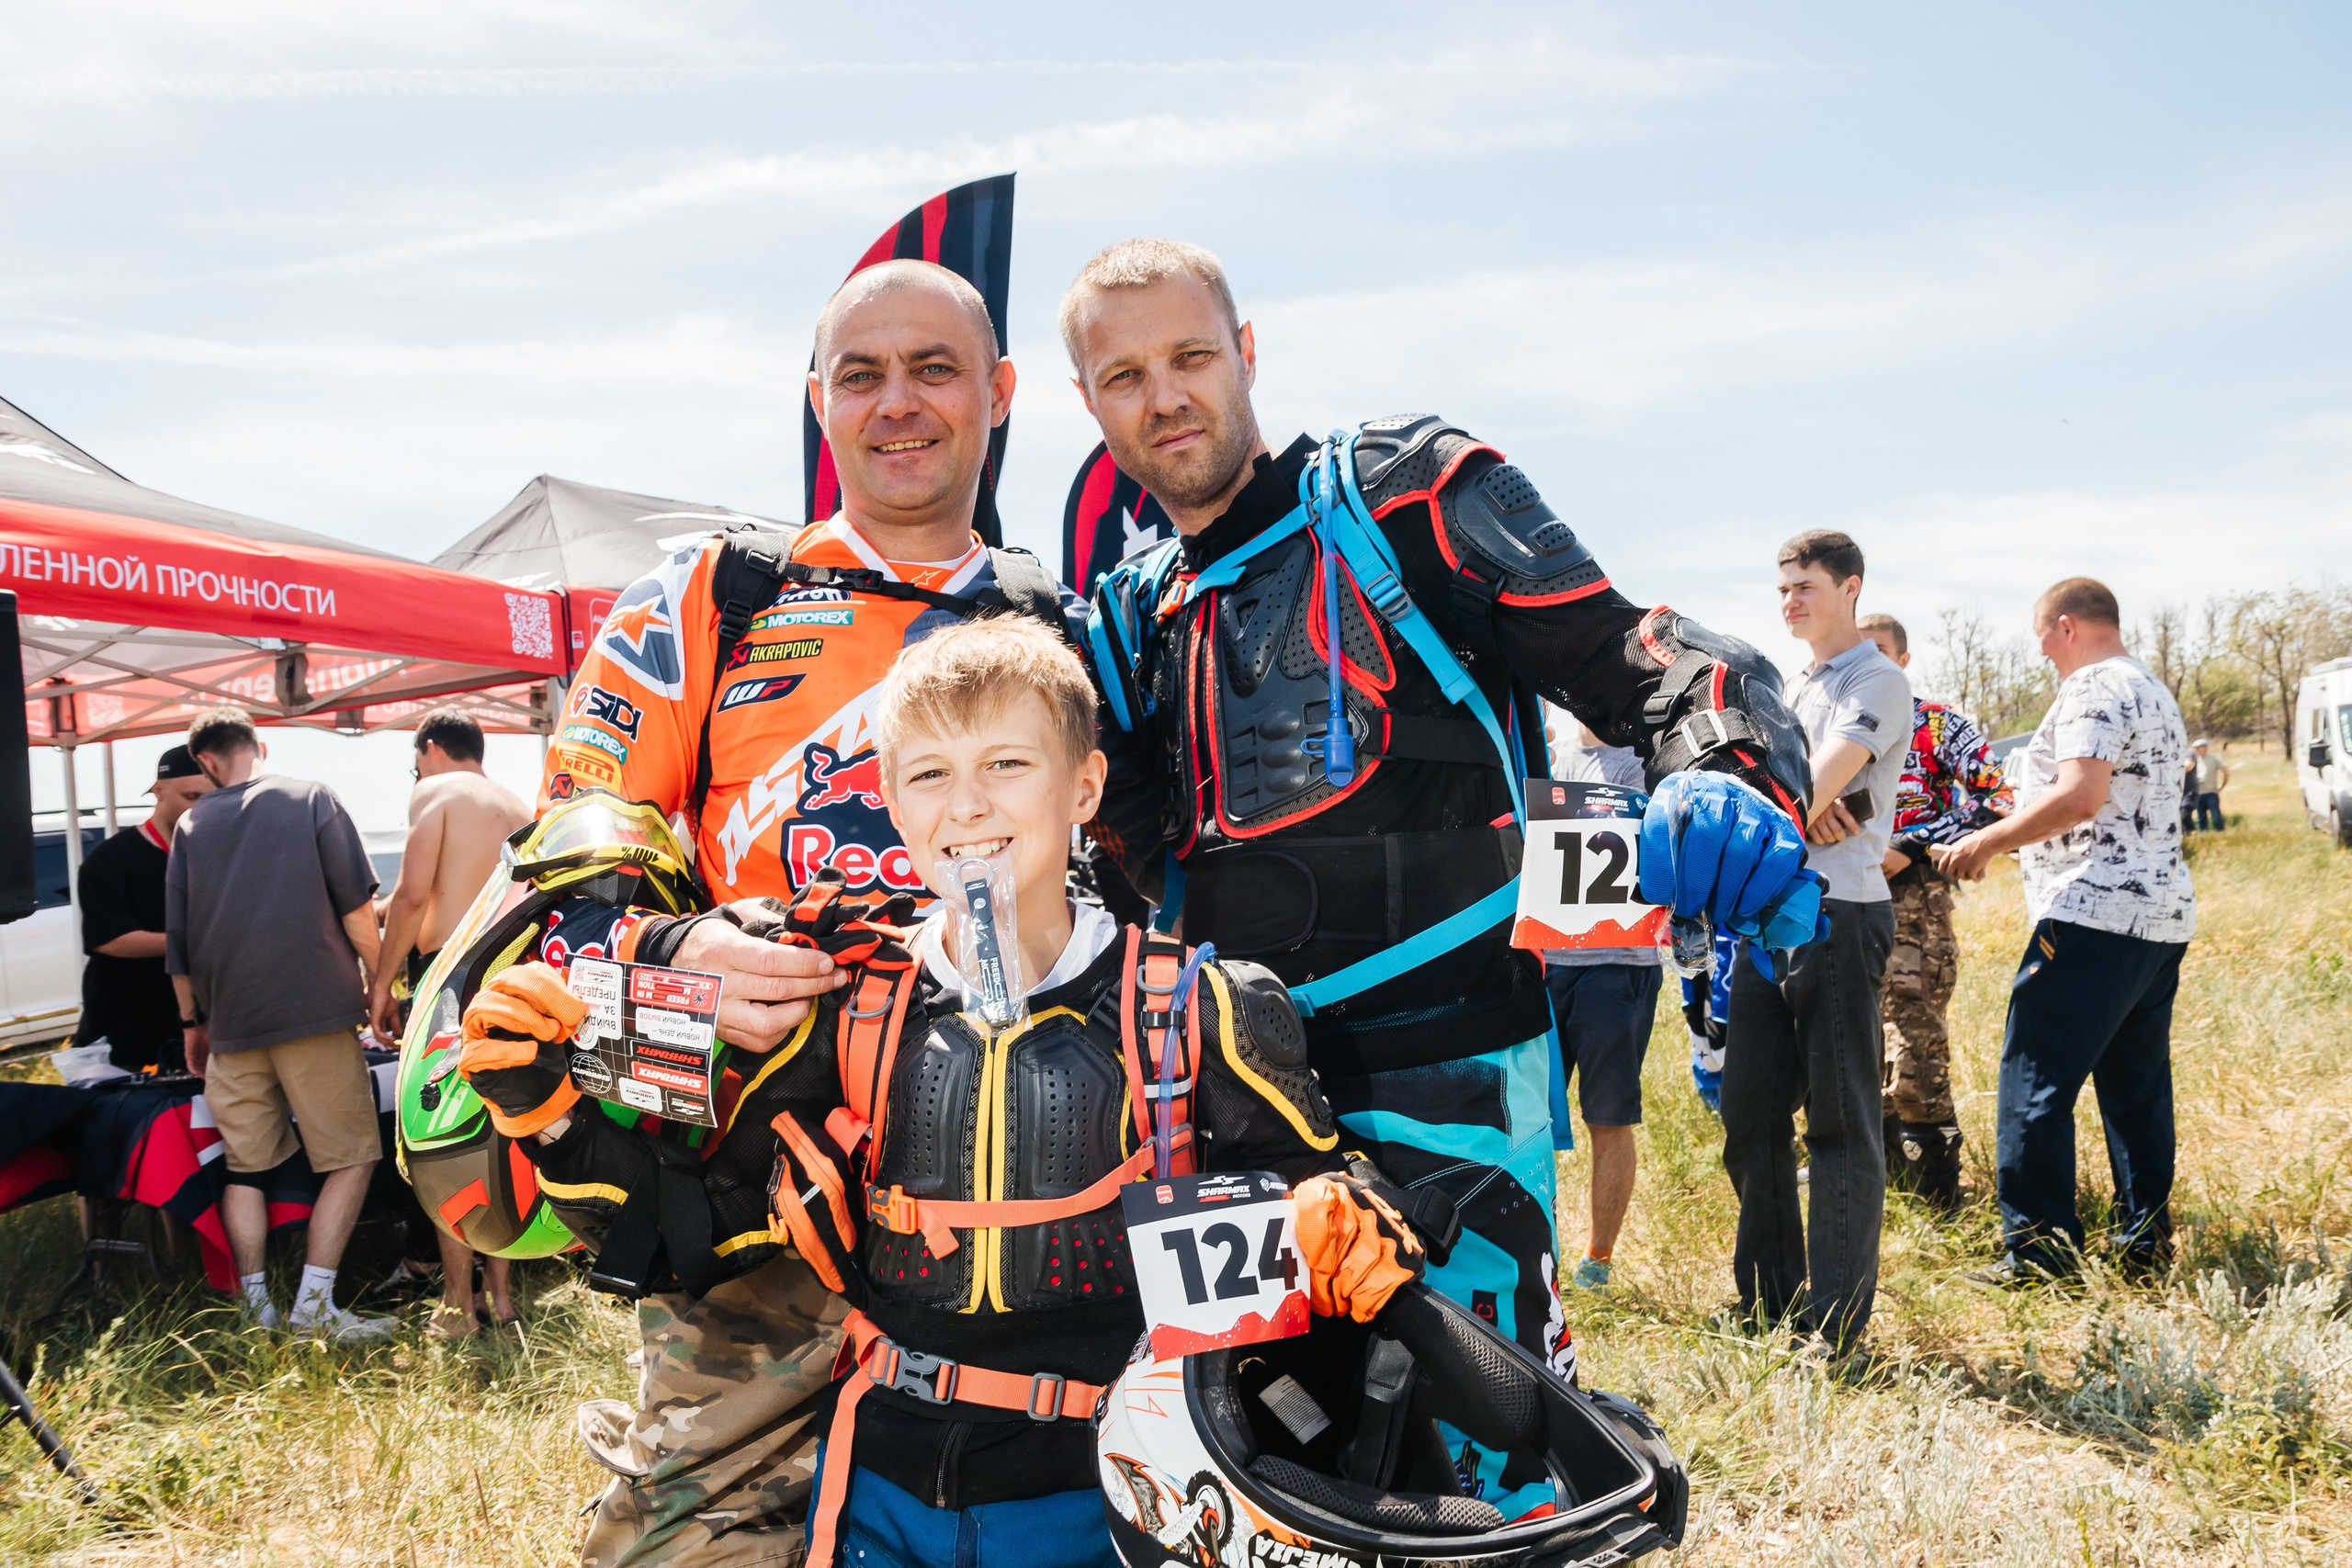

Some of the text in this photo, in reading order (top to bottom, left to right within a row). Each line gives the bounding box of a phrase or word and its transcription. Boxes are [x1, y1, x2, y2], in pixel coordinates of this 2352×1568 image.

[155, 563, 336, 617] ПРОЧНОСТИ
[768, 610, 849, 628] MOTOREX
[749, 638, 822, 662] AKRAPOVIČ
[724, 679, 793, 707] WP
[573, 726, 627, 762] MOTOREX
[1584, 796, 1628, 807] SHARMAX
[621, 846, 660, 863] 100%
[1554, 830, 1651, 906] 12
[572, 984, 616, 1001] ПРЕДЕЛЫ
[604, 1004, 616, 1016] ЗА
[639, 1011, 686, 1026] НОВЫЙ ВЫЗОВ
[658, 1028, 675, 1037] ДЕНЬ
[676, 1032, 700, 1041] НОВЫЙ
[636, 1045, 704, 1066] SHARMAX
[638, 1066, 704, 1089] SHARMAX
[1197, 1184, 1250, 1198] SHARMAX
[1160, 1217, 1298, 1305] 124
